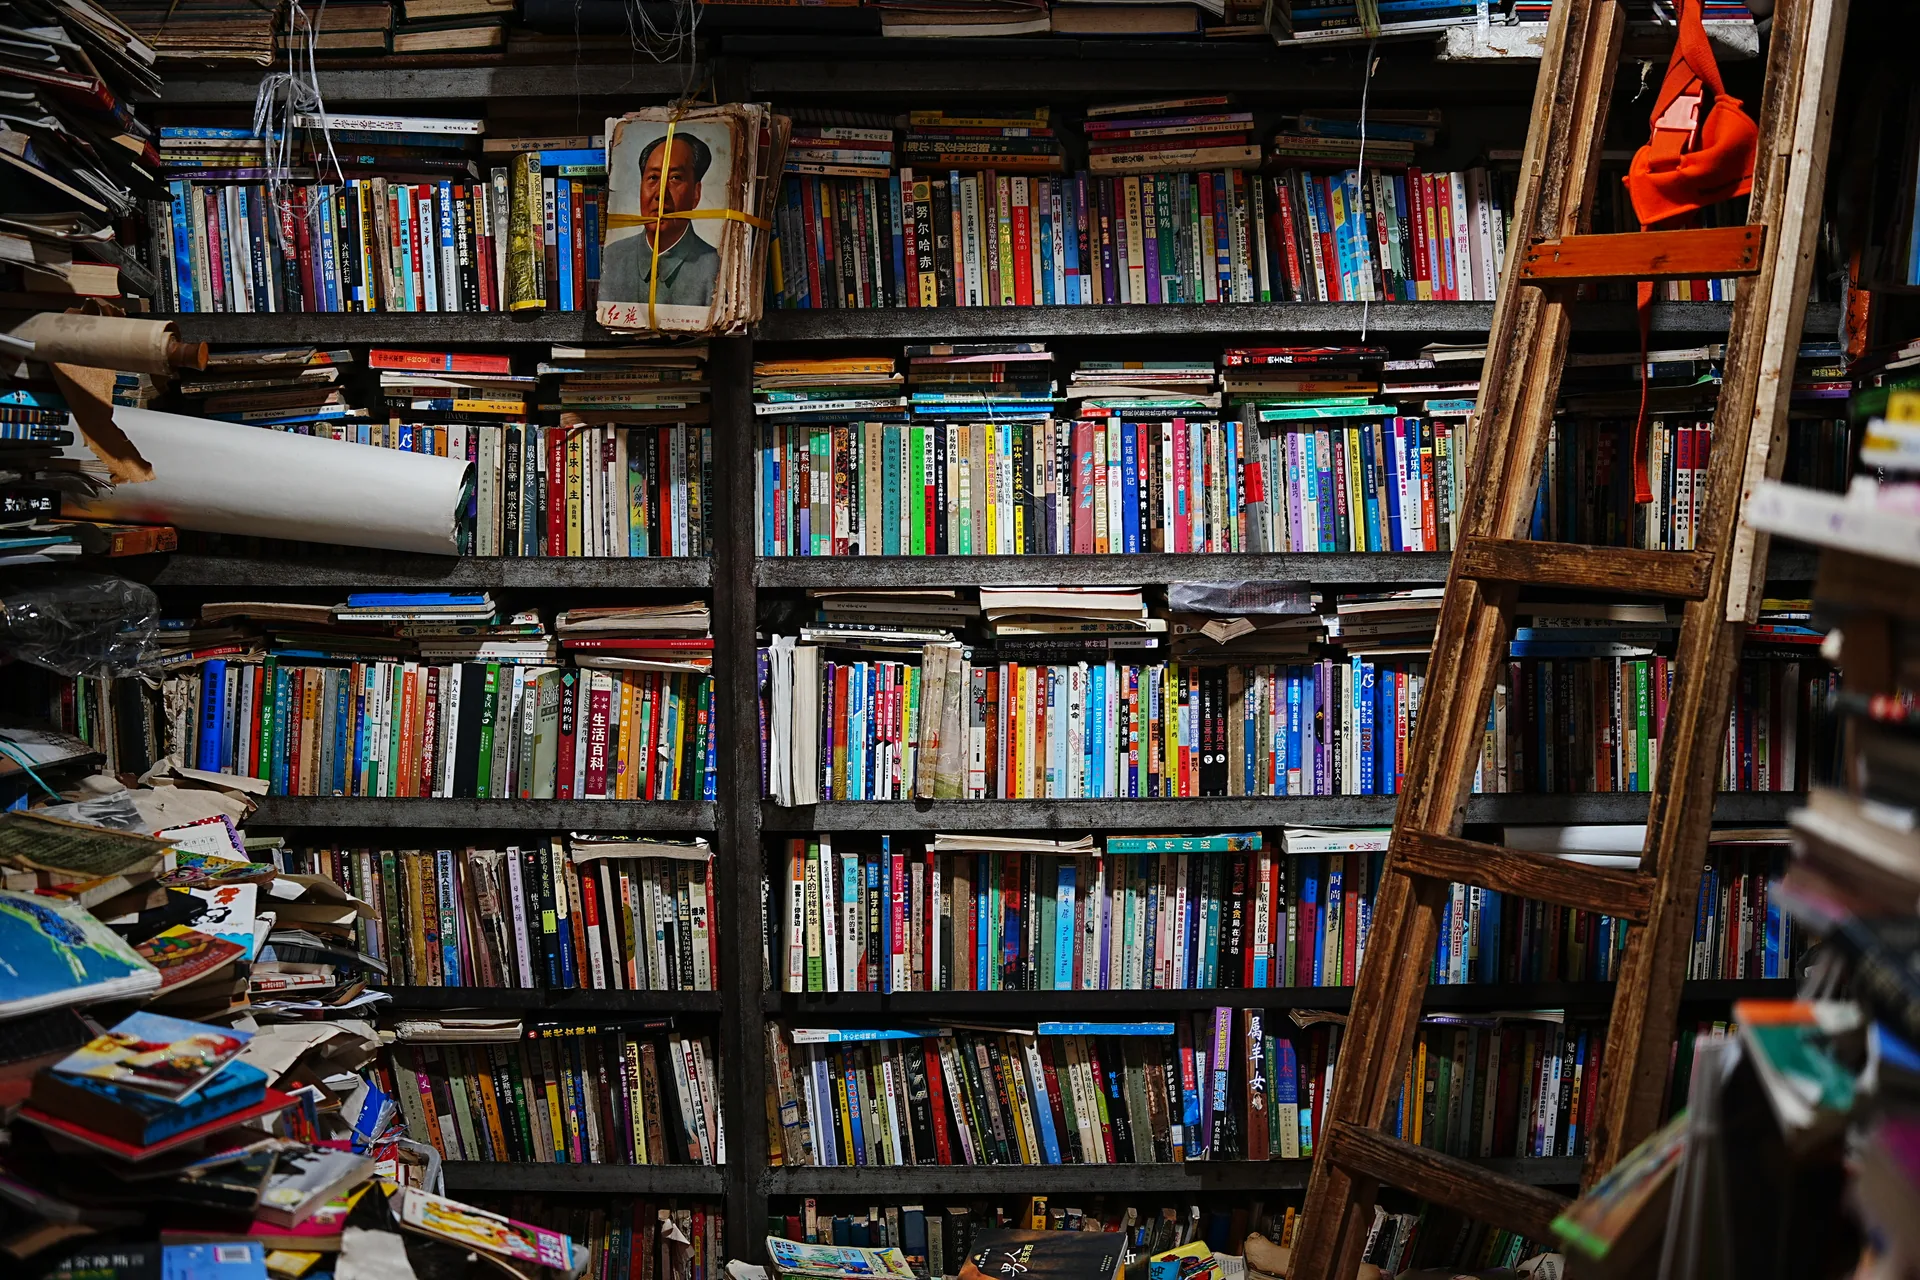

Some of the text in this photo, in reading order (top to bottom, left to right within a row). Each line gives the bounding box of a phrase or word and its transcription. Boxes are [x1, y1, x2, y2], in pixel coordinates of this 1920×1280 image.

[442, 187, 451, 238] 对话与交流
[1053, 196, 1063, 255] 中庸·大学
[323, 239, 334, 281] 世纪爱情
[843, 236, 853, 277] 火线大行动
[905, 227, 915, 256] 柯云路
[916, 206, 931, 269] 努尔哈赤
[1458, 224, 1468, 253] 邓丽君
[342, 243, 351, 283] 火线大行动
[607, 304, 638, 325] 红旗
[444, 412, 470, 420] FINANCE
[569, 442, 579, 500] 安乐公主
[888, 440, 896, 494] 外国历史名人传
[1125, 435, 1134, 486] 宫廷恩仇记
[507, 443, 518, 530] 雍正皇帝·恨水东逝
[563, 689, 572, 731] 失落的约柜
[1070, 703, 1080, 719] 使命
[590, 713, 606, 771] 生活百科
[698, 711, 707, 760] 生存不难
[1362, 728, 1371, 753] IBM
[808, 865, 817, 925] 北大的花样年华
[1330, 874, 1342, 899] 时尚
[1231, 901, 1242, 955] 反贪局在行动
[1258, 883, 1268, 944] 儿童成长故事
[627, 1045, 639, 1089] 无敌之师
[1248, 1016, 1266, 1090] 属羊女
[1001, 1248, 1028, 1277] 男人
